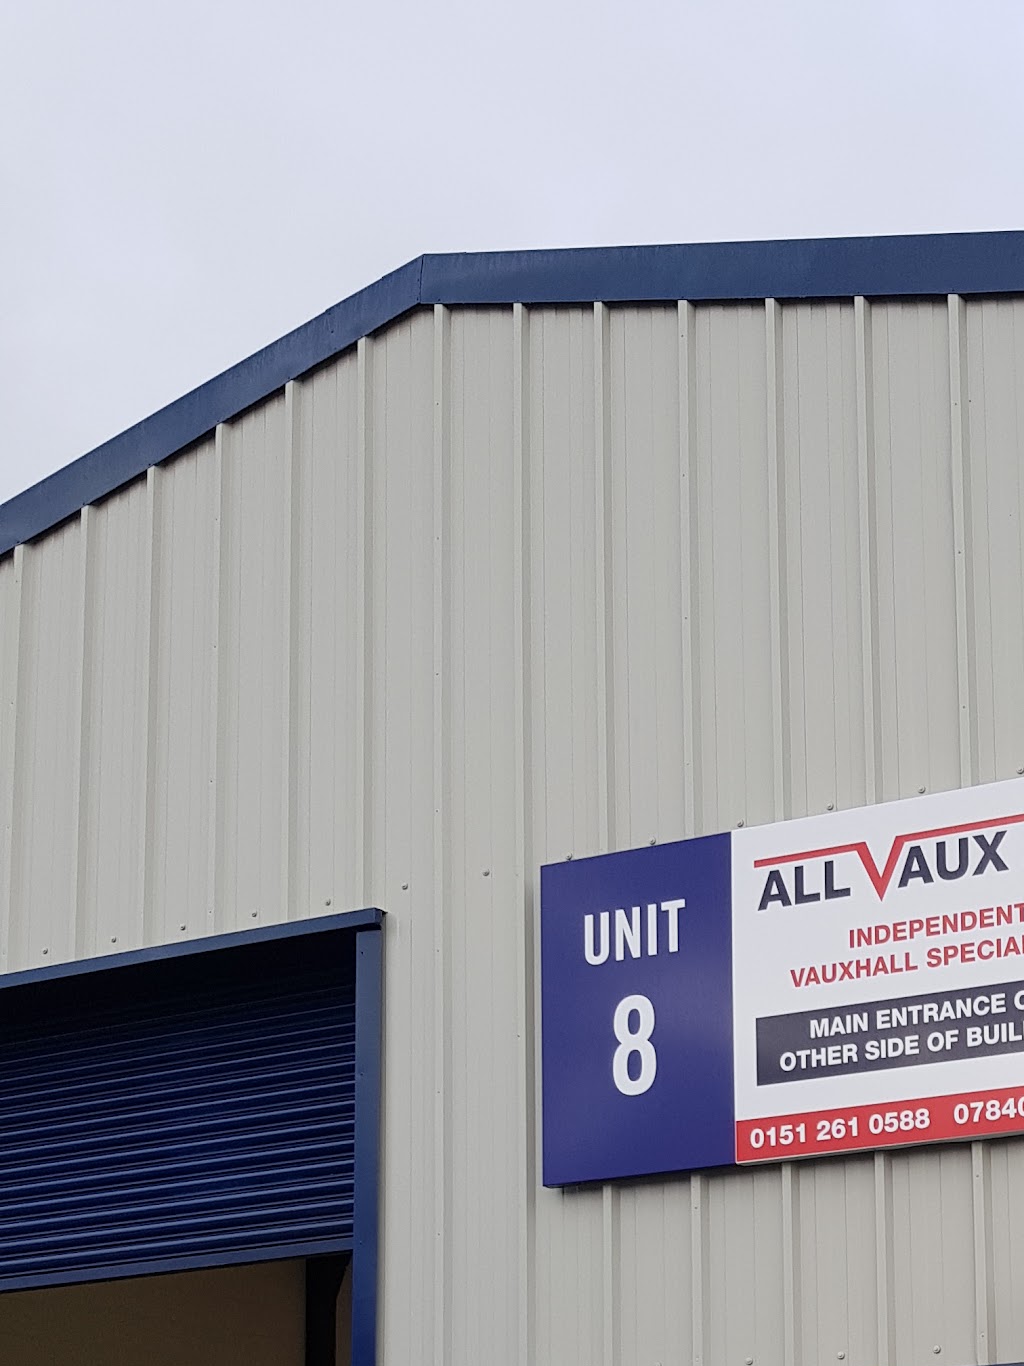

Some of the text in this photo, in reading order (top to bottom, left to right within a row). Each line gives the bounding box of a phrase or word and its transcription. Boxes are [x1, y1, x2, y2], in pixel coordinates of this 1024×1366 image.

[757, 860, 851, 911] ALL
[855, 830, 1009, 902] VAUX
[584, 898, 686, 966] UNIT
[790, 952, 918, 988] VAUXHALL
[809, 1012, 869, 1040] MAIN
[876, 993, 1006, 1031] ENTRANCE
[612, 994, 657, 1096] 8
[779, 1041, 858, 1073] OTHER
[864, 1035, 920, 1060] SIDE
[926, 1029, 960, 1051] OF
[749, 1123, 806, 1149] 0151
[815, 1115, 860, 1140] 261
[868, 1107, 931, 1132] 0588
